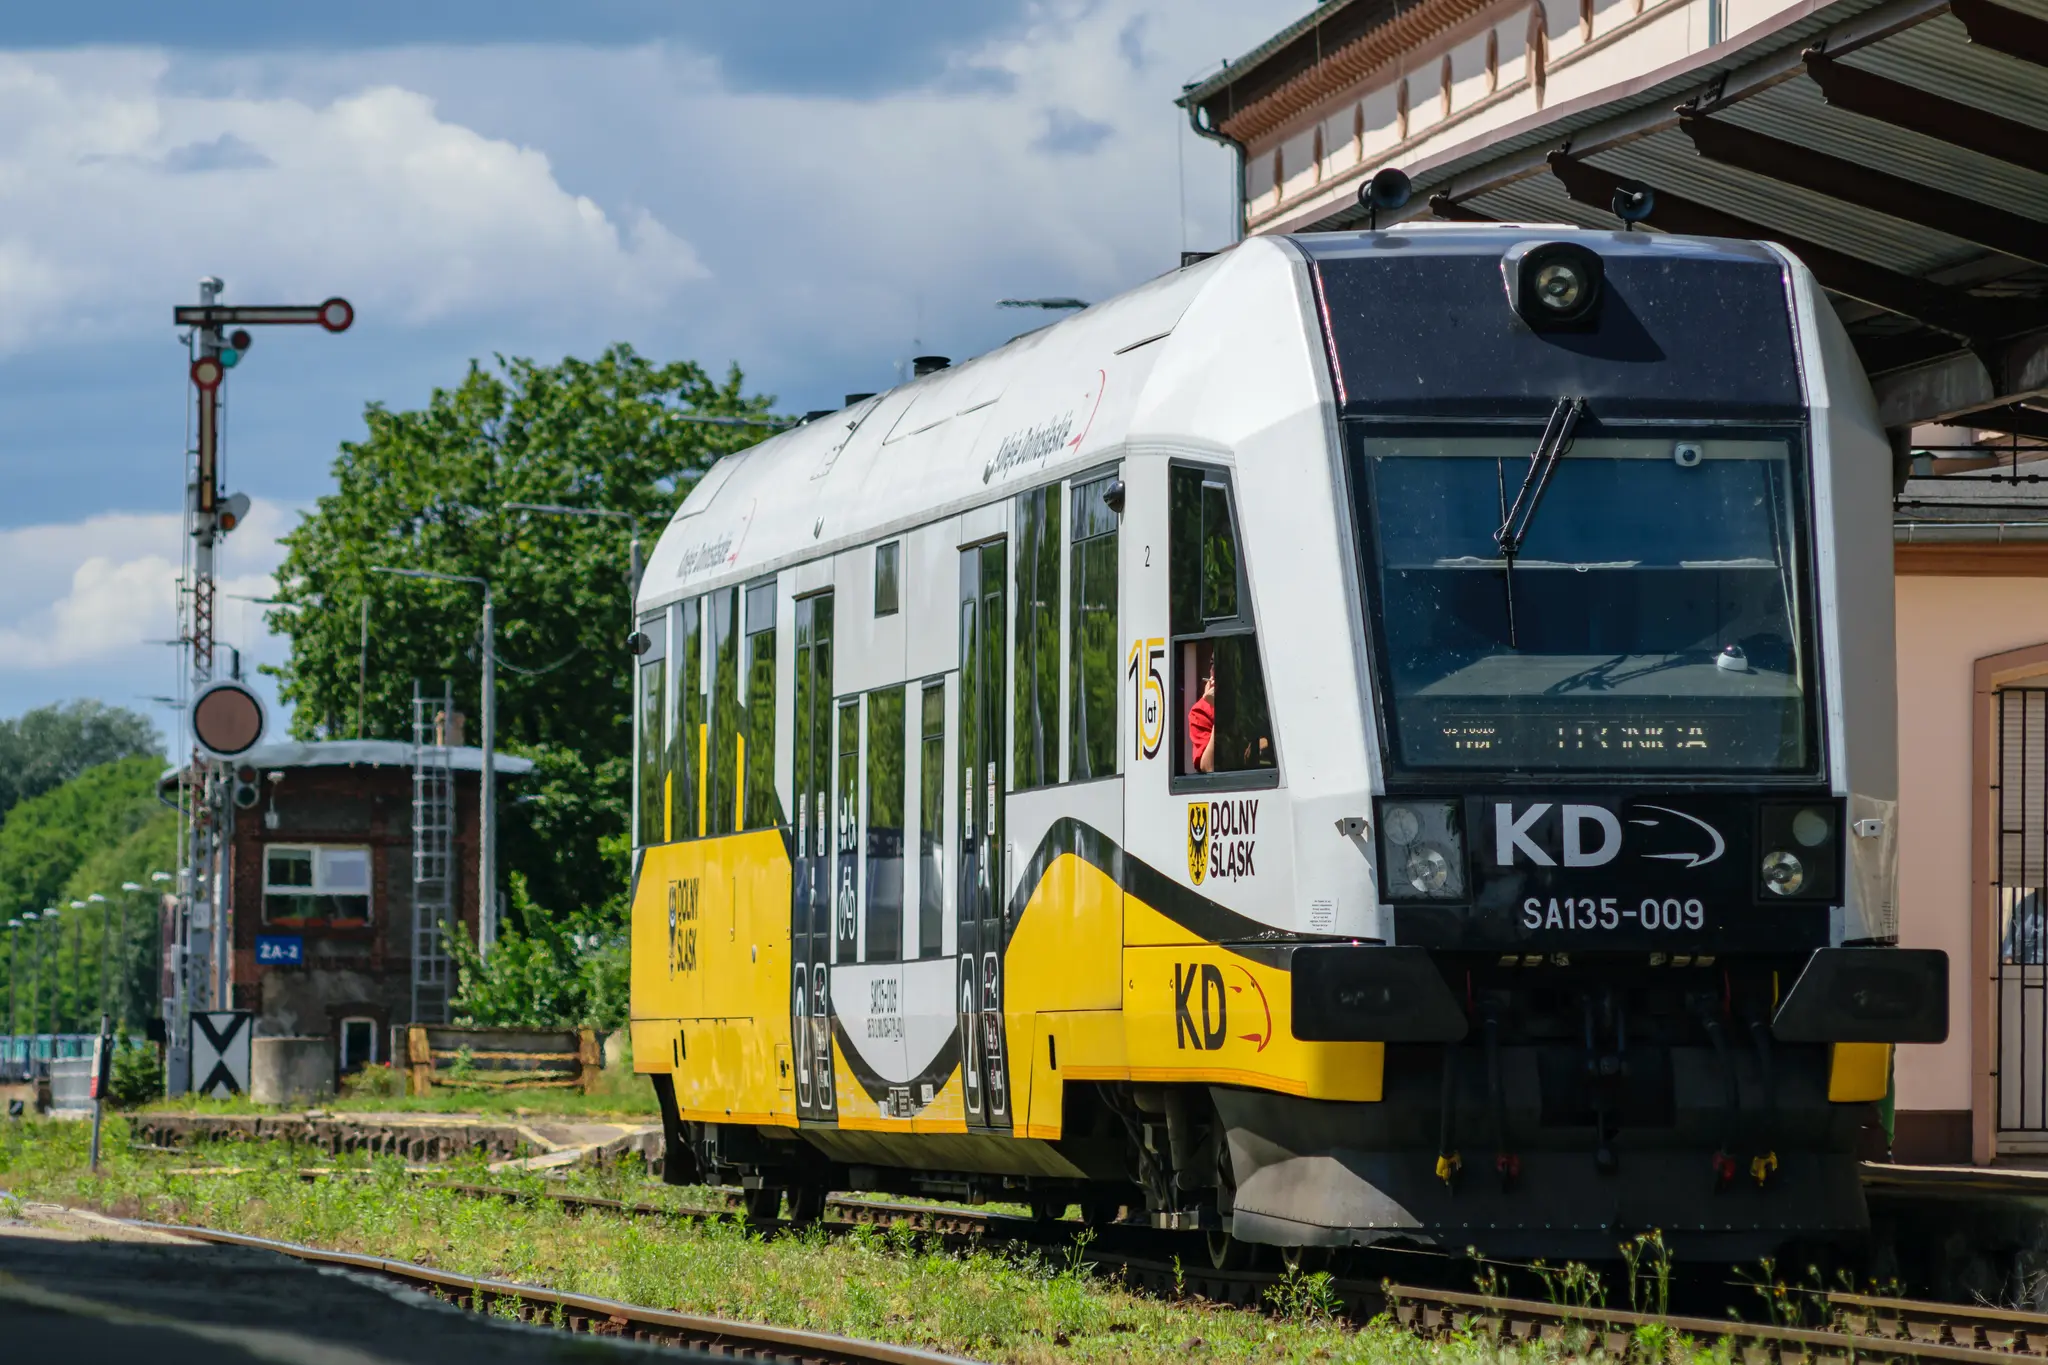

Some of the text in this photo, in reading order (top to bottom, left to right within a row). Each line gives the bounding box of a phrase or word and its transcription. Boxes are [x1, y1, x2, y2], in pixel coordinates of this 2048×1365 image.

[1144, 545, 1151, 567] 2
[1128, 637, 1165, 761] 15
[1144, 698, 1157, 724] lat
[1211, 799, 1259, 837] DOLNY
[1494, 803, 1622, 868] KD
[1210, 834, 1256, 883] ŚLĄSK
[678, 878, 699, 921] DOLNY
[1523, 897, 1704, 930] SA135-009
[1174, 962, 1228, 1051] KD
